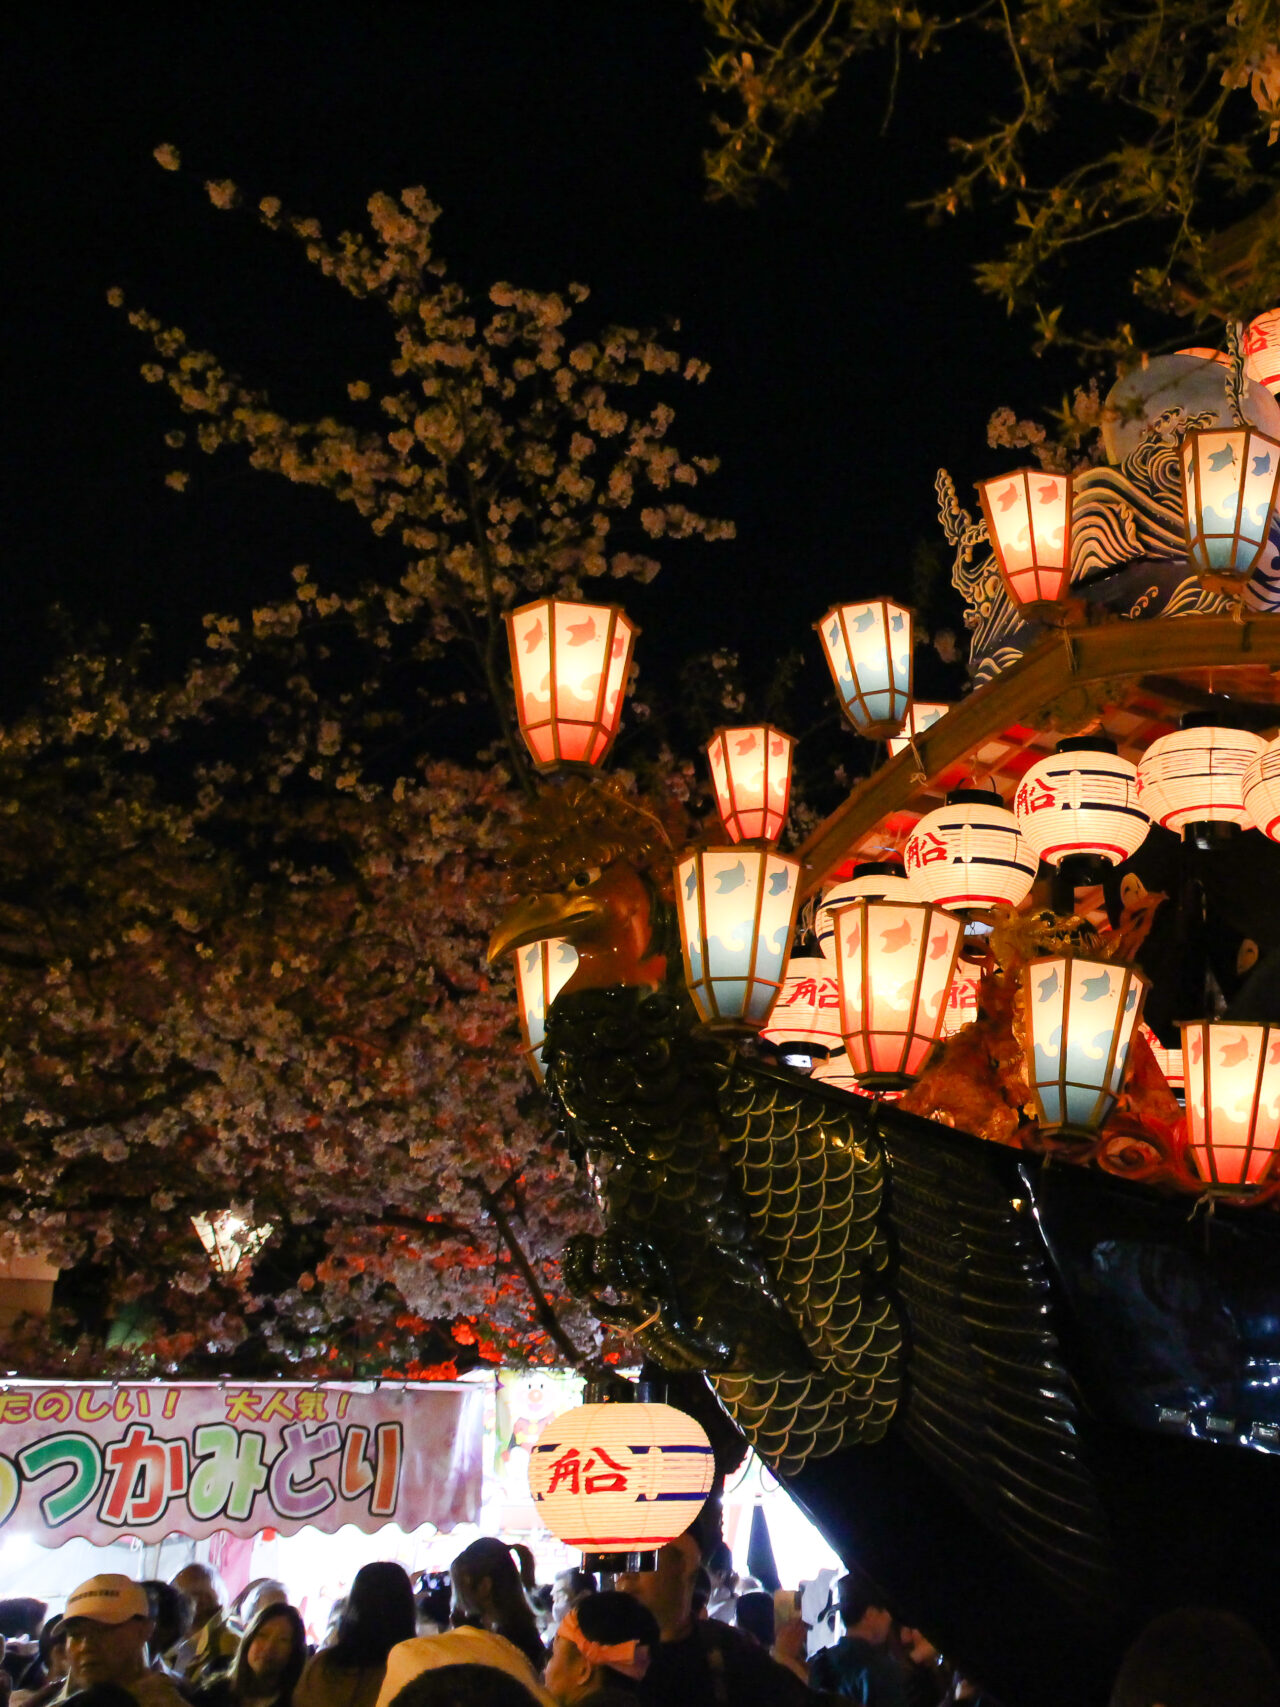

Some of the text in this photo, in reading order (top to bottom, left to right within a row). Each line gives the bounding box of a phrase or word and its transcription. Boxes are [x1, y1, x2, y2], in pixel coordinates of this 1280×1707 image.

[1016, 778, 1057, 819] 船
[906, 831, 949, 873] 船
[786, 977, 839, 1009] 船
[224, 1391, 352, 1422] 大人気！
[546, 1446, 632, 1495] 船
